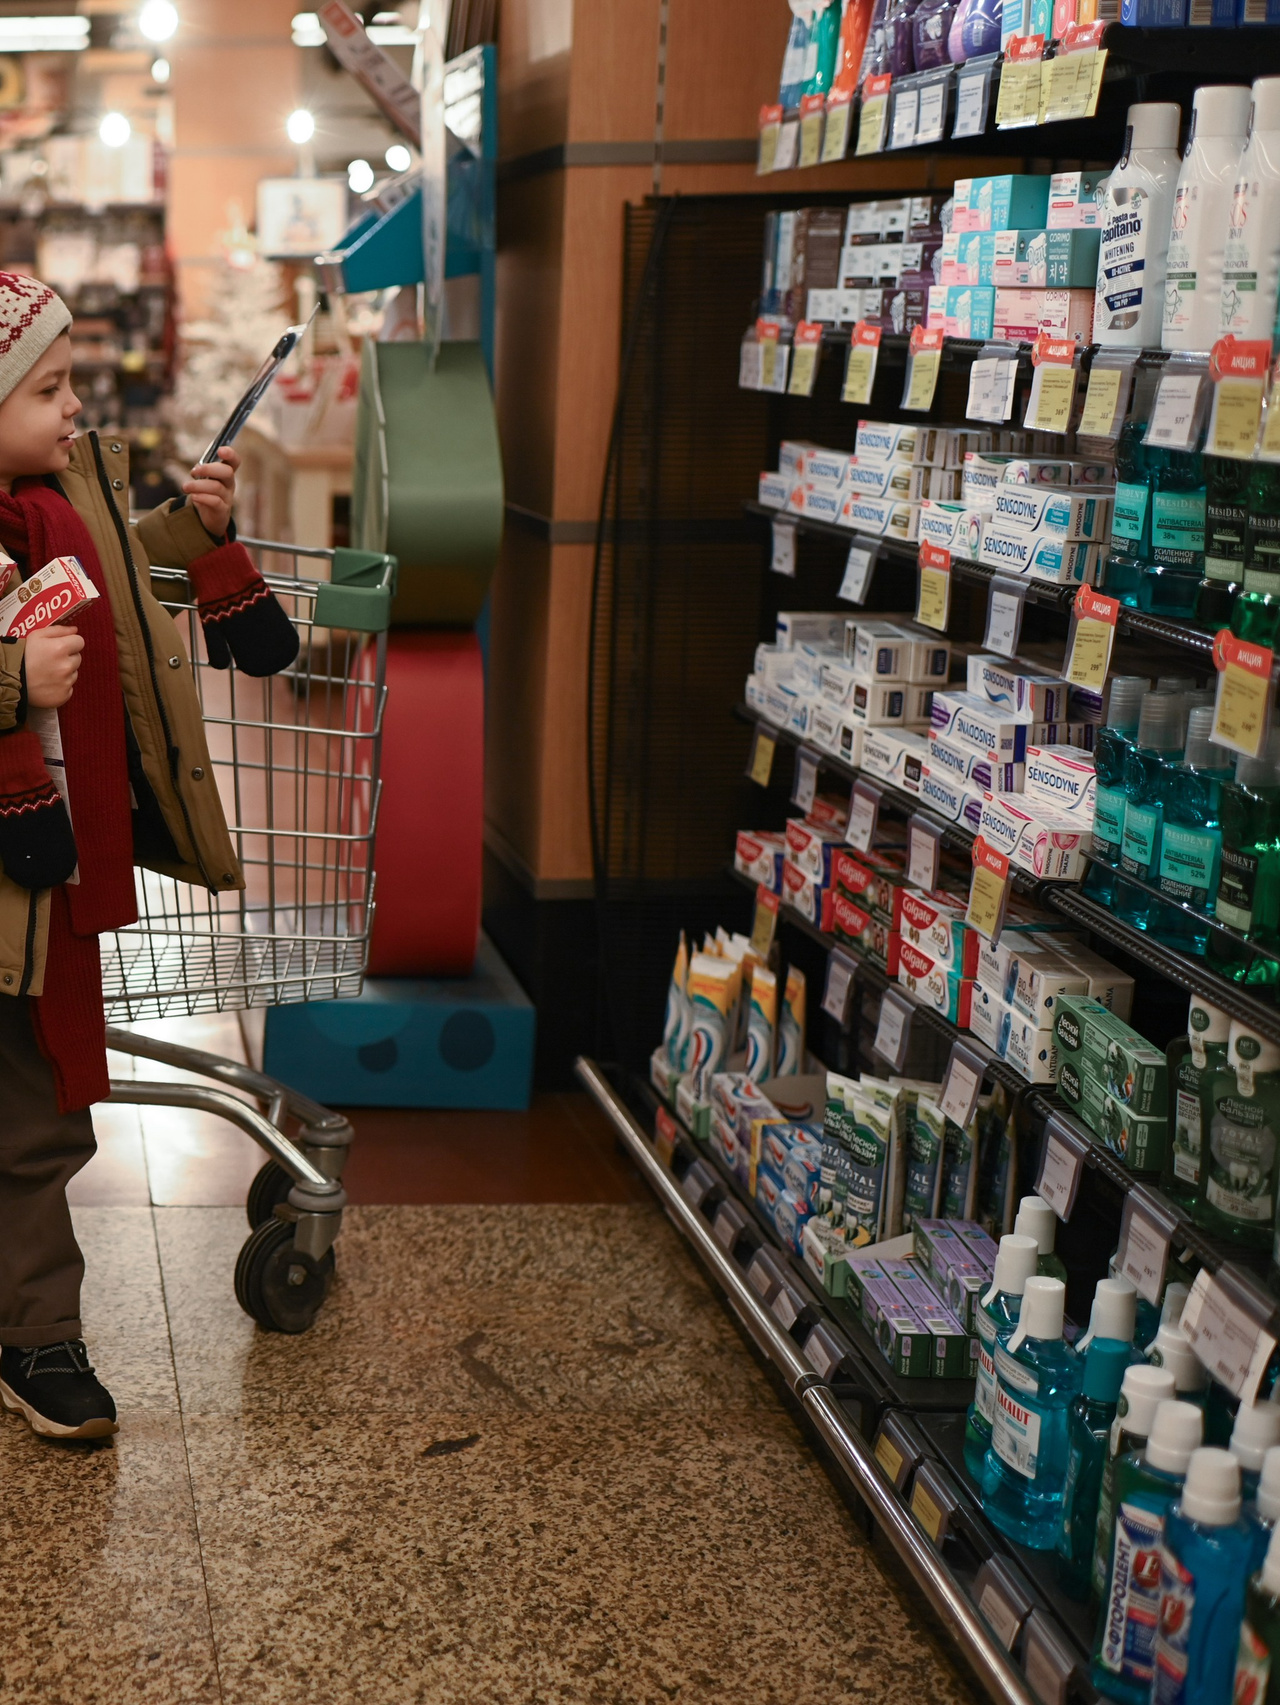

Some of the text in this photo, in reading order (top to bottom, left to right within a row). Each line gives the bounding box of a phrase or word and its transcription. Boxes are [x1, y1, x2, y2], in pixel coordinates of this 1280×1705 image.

[1112, 212, 1138, 226] Pasta del
[1104, 242, 1135, 261] WHITENING
[1046, 291, 1068, 302] CORIMO
[1231, 356, 1256, 370] АКЦИЯ
[858, 433, 891, 450] SENSODYNE
[850, 468, 884, 486] SENSODYNE
[964, 470, 997, 488] SENSODYNE
[852, 505, 884, 523] SENSODYNE
[996, 496, 1038, 519] SENSODYNE
[921, 517, 953, 537] SENSODYNE
[1075, 502, 1084, 537] SENSODYNE
[1158, 517, 1205, 527] ANTIBACTERIAL
[1216, 527, 1236, 537] CLASSIC
[983, 536, 1028, 561] SENSODYNE
[1154, 547, 1194, 558] УСИЛЕННОЕ
[1066, 546, 1076, 581] SENSODYNE
[1154, 554, 1193, 565] ОЧИЩЕНИЕ
[10, 588, 72, 639] Colgate
[1091, 601, 1111, 616] АКЦИЯ
[1236, 650, 1263, 668] АКЦИЯ
[982, 667, 1015, 693] SENSODYNE
[957, 717, 996, 749] SENSODYNE
[930, 742, 965, 774] SENSODYNE
[1027, 765, 1080, 797] SENSODYNE
[922, 778, 957, 811] SENSODYNE
[981, 811, 1017, 843] SENSODYNE
[1164, 829, 1212, 846] PRESIDENT
[985, 853, 1003, 871] АКЦИЯ
[1044, 848, 1053, 875] SENSODYNE
[1166, 849, 1205, 863] ANTIBACTERIAL
[838, 856, 867, 888] Colgate
[1190, 869, 1206, 880] 52%
[1160, 877, 1193, 893] УСИЛЕННОЕ
[1160, 885, 1192, 899] ОЧИЩЕНИЕ
[835, 900, 863, 930] Colgate
[902, 896, 932, 924] Colgate
[931, 926, 946, 945] Total
[900, 944, 928, 974] Colgate
[928, 975, 942, 995] Total
[1017, 977, 1026, 992] BIO
[1017, 988, 1036, 1012] MINERAL
[1060, 1014, 1079, 1036] Лесной
[1011, 1029, 1019, 1044] BIO
[1057, 1023, 1079, 1049] Бальзам
[1010, 1041, 1030, 1065] MINERAL
[1060, 1065, 1079, 1089] Лесной
[1060, 1074, 1079, 1101] Бальзам
[1220, 1102, 1263, 1122] Бальзам
[1227, 1098, 1264, 1114] Лесной
[1222, 1127, 1262, 1144] TOTAL
[998, 1389, 1031, 1426] LACALUT
[1108, 1540, 1131, 1646] ФТОРОДЕНТ
